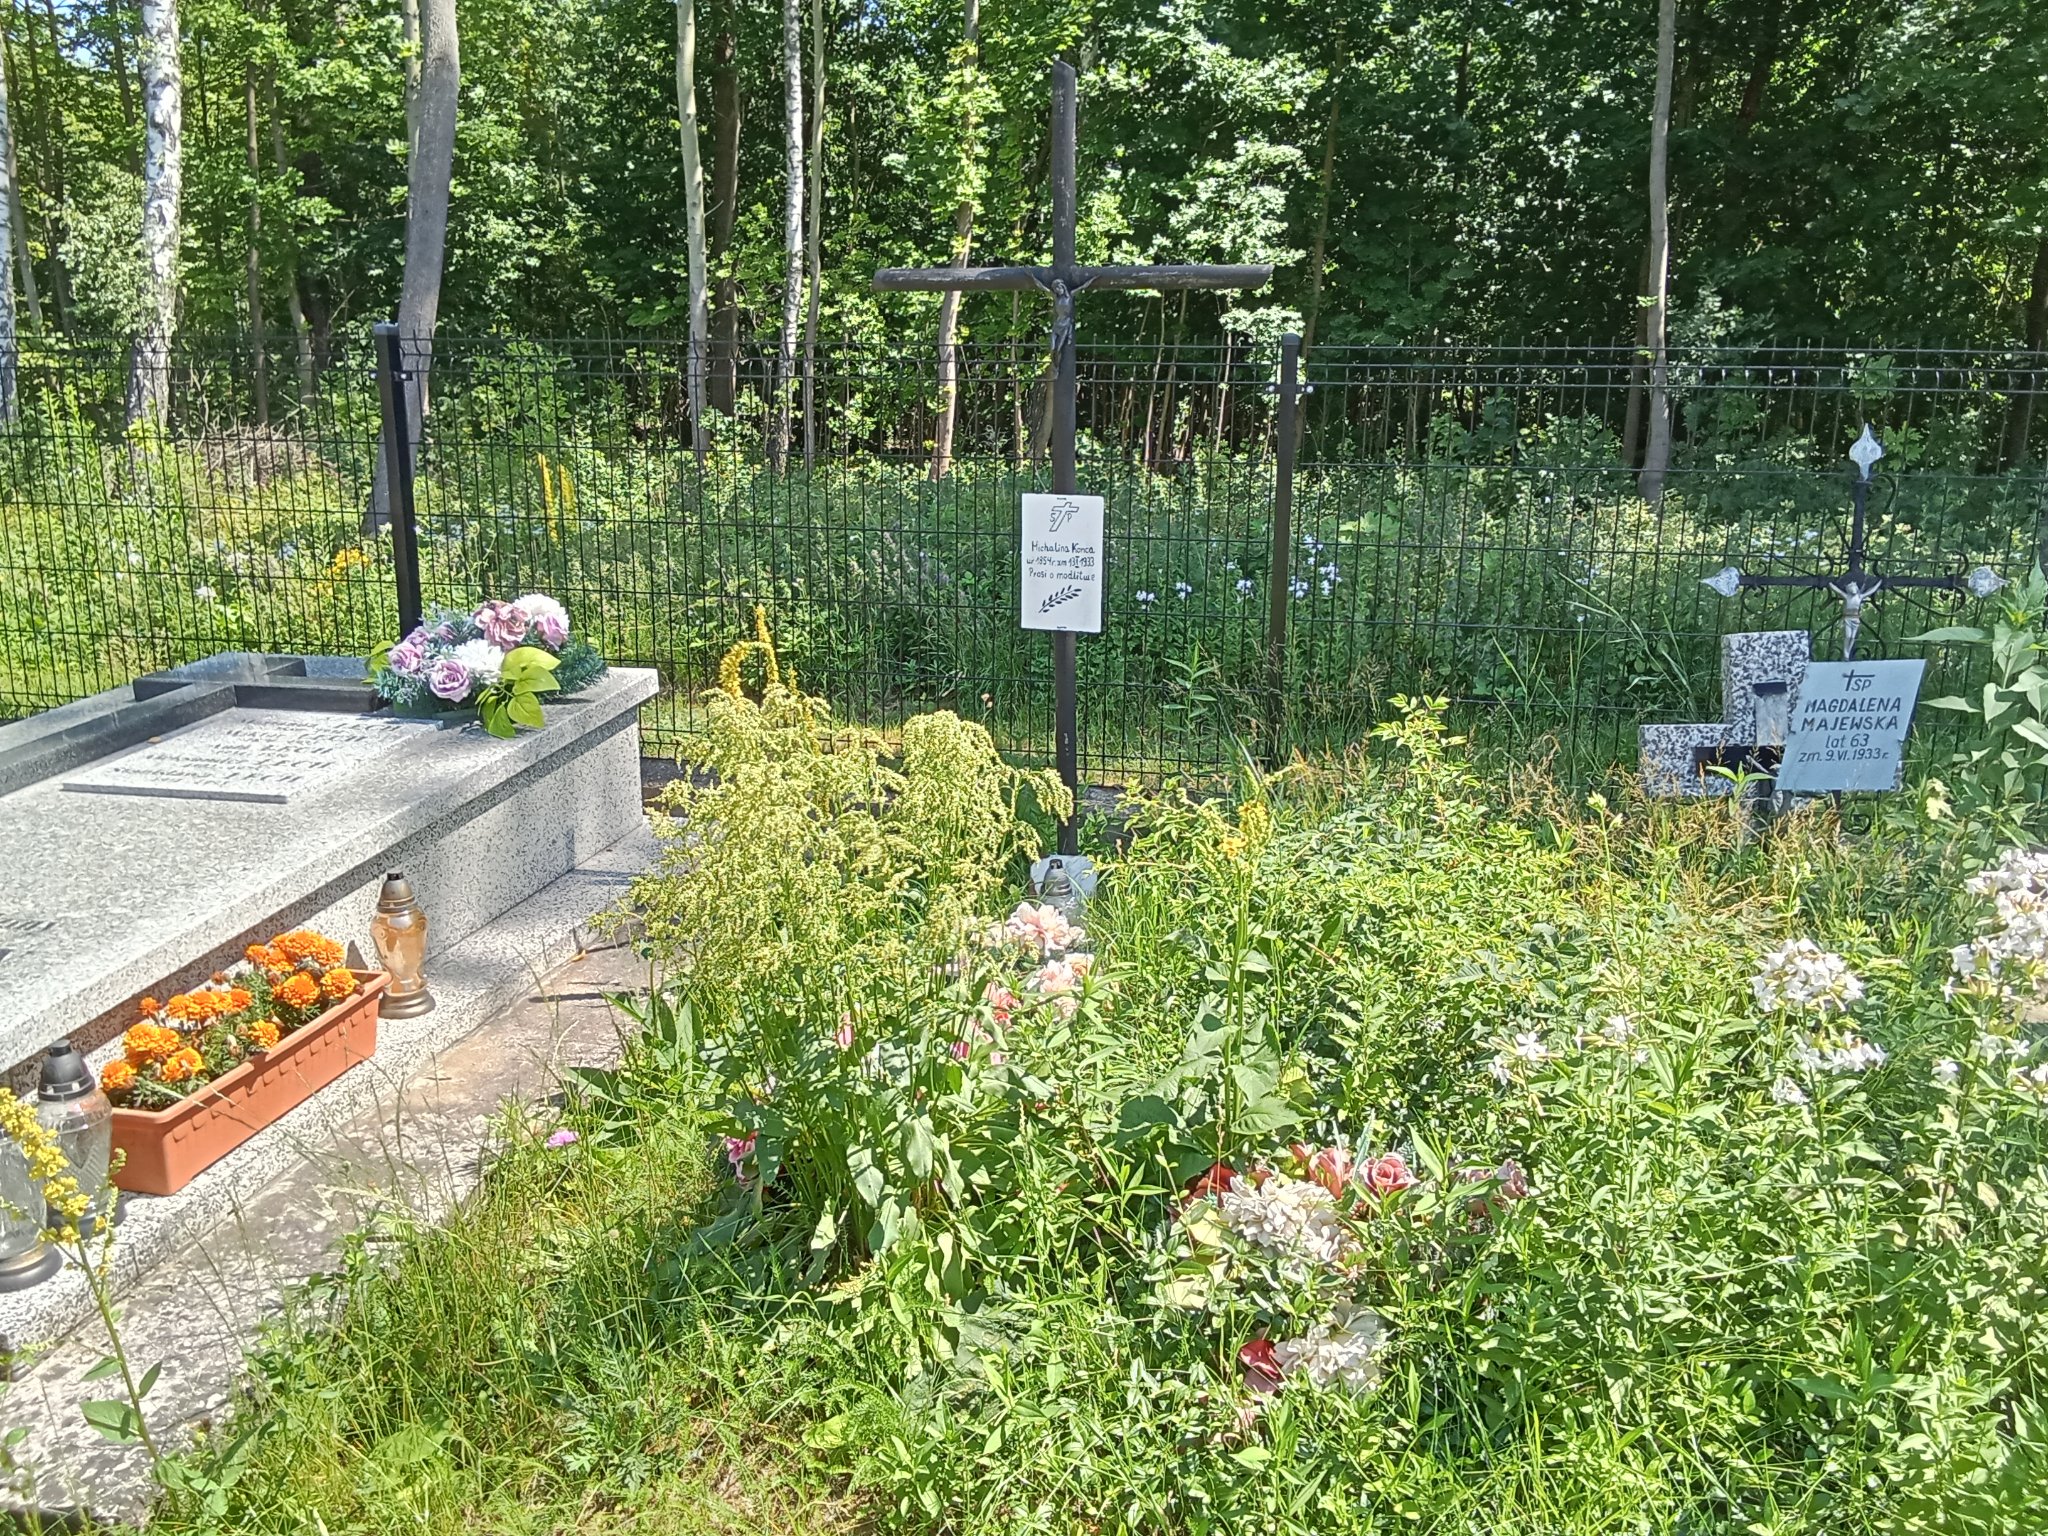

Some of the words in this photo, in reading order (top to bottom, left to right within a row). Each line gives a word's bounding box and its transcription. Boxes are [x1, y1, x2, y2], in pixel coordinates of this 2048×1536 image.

[1028, 566, 1047, 579] Prosi
[1804, 696, 1902, 714] MAGDALENA
[1800, 715, 1899, 732] MAJEWSKA
[1825, 734, 1846, 749] lat
[1850, 732, 1870, 748] 63
[1798, 751, 1822, 762] zm.
